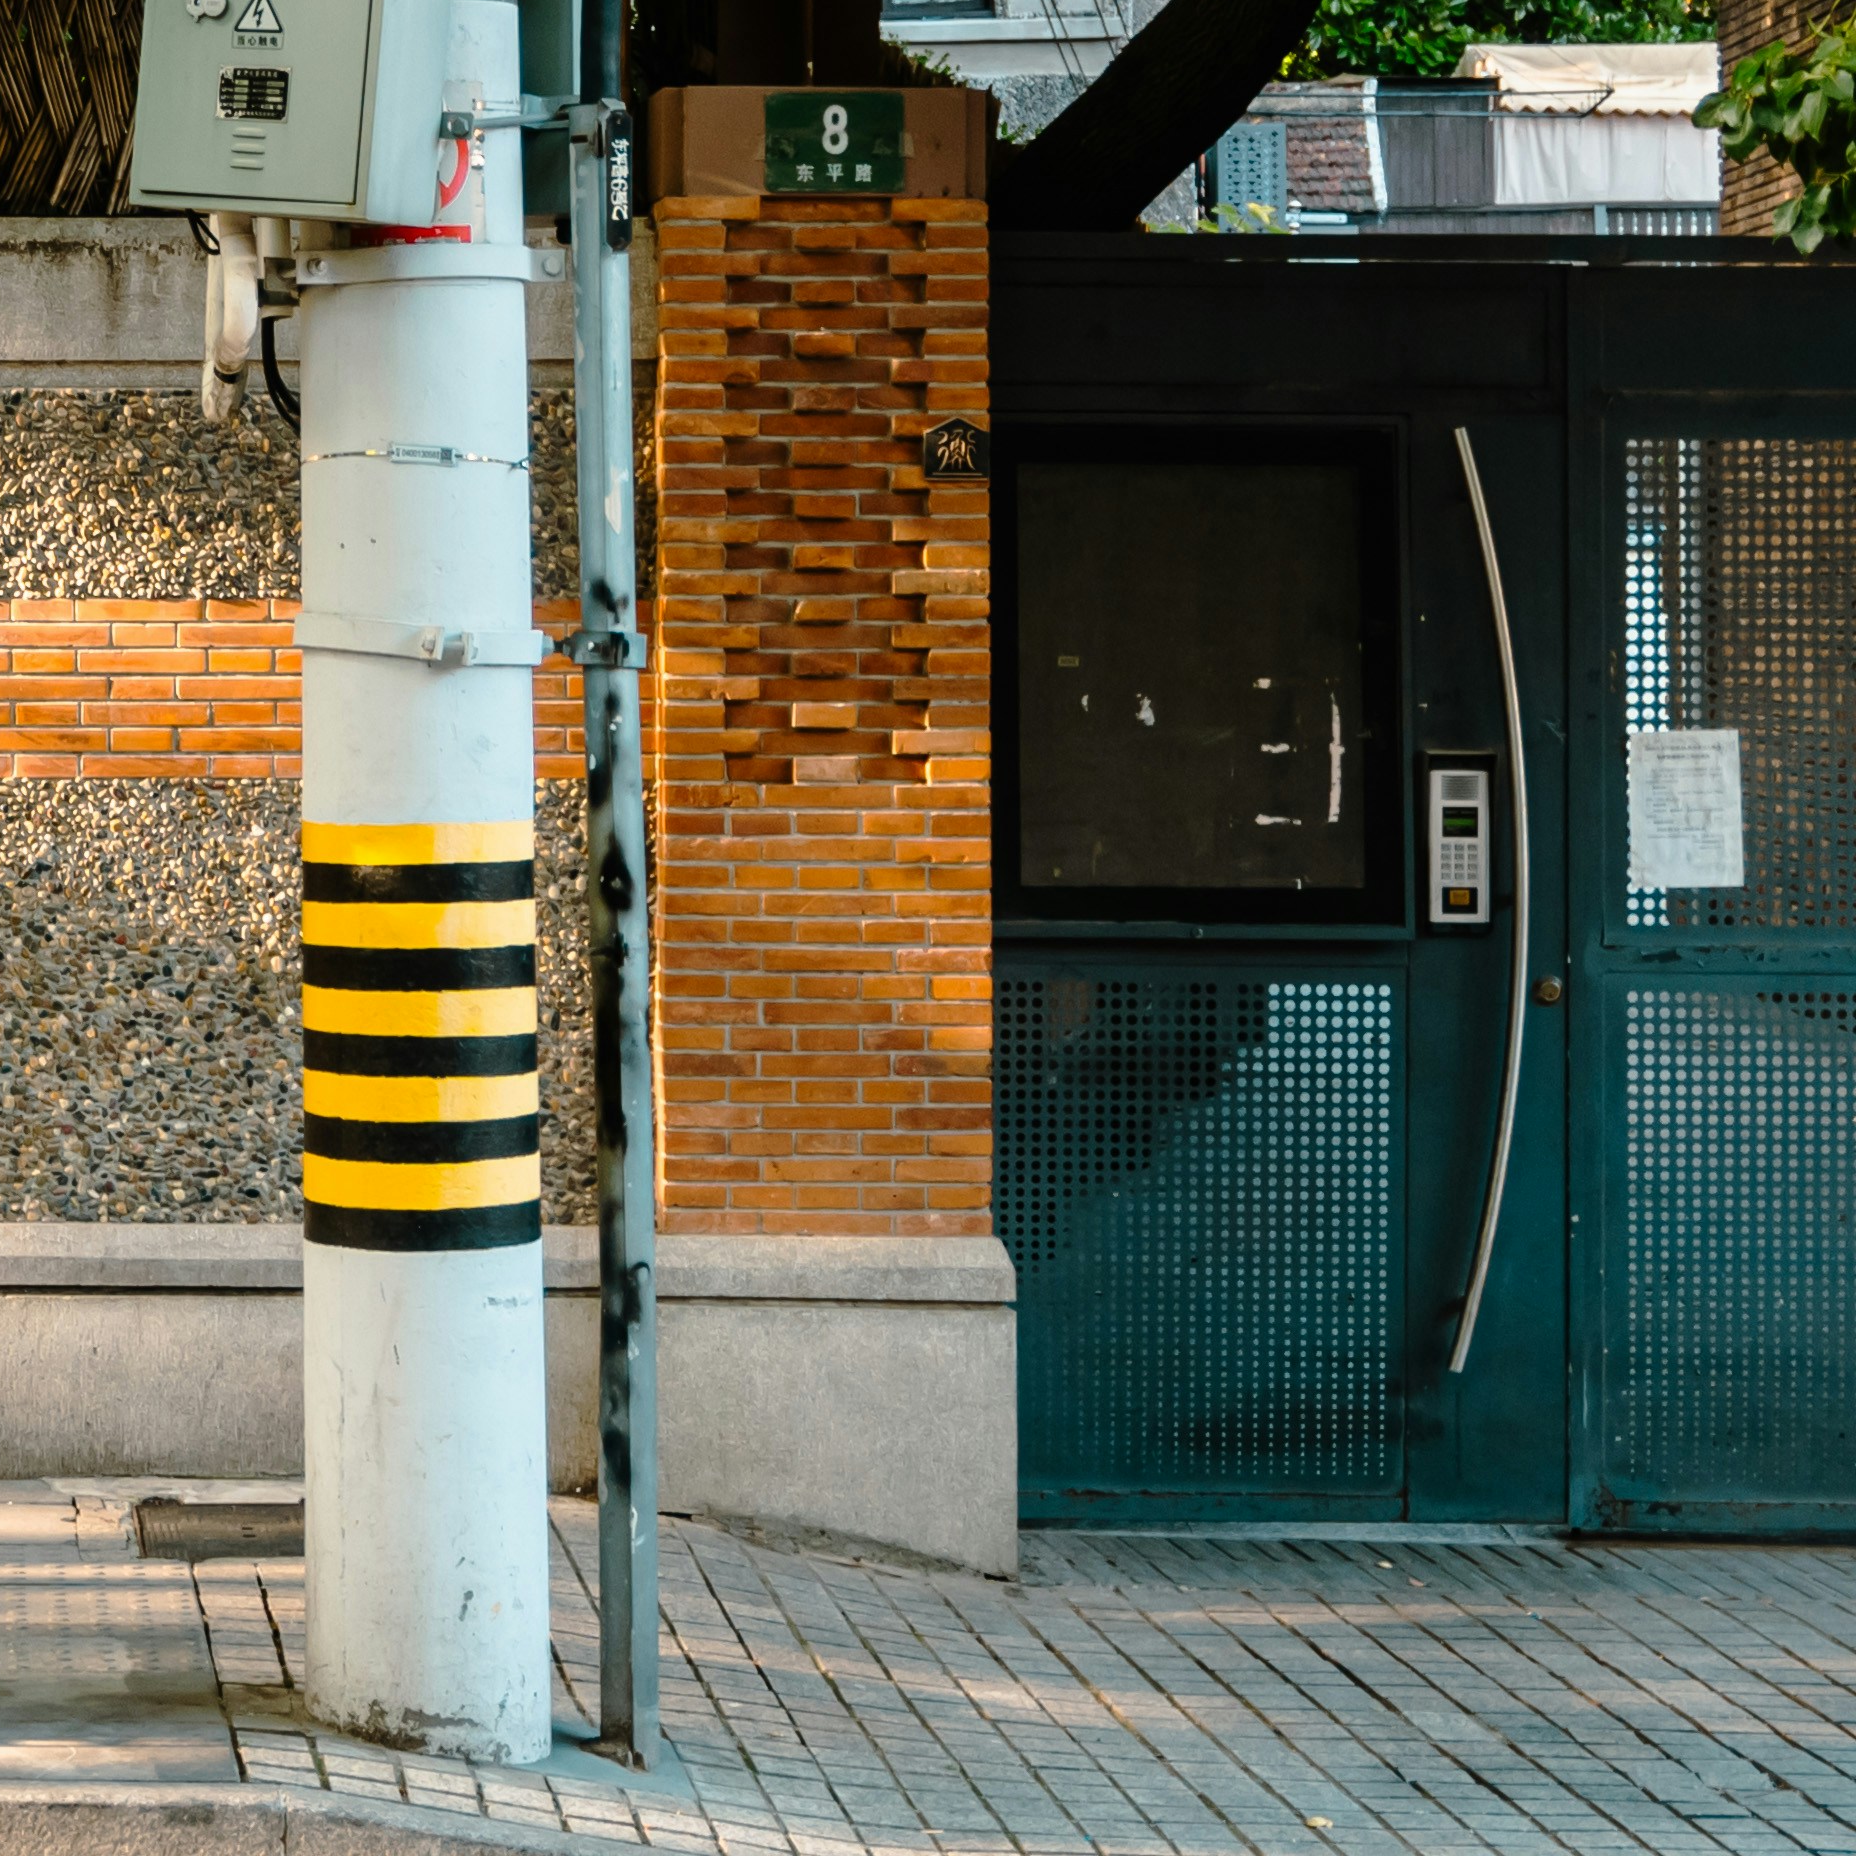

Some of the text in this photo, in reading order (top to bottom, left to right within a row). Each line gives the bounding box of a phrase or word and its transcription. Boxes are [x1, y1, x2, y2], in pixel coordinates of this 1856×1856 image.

[821, 104, 849, 155] 8
[795, 163, 872, 184] 东平路
